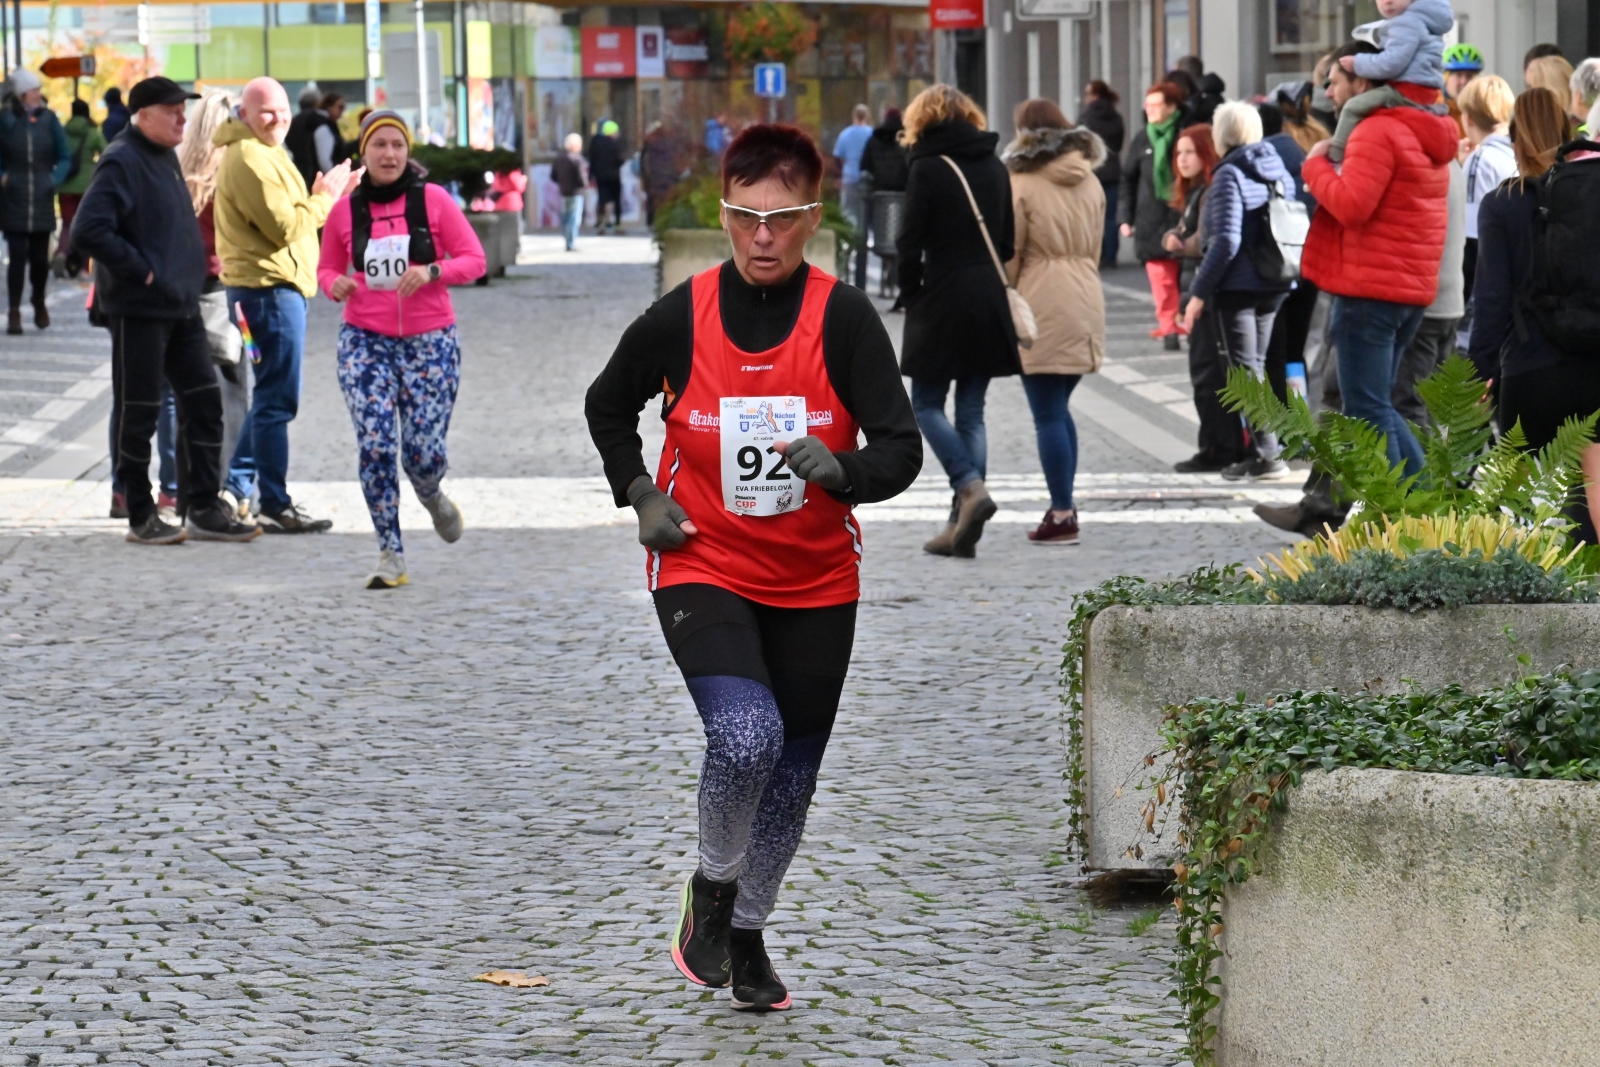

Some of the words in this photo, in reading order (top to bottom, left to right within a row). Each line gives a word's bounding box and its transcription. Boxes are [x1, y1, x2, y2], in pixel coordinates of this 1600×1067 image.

[366, 258, 407, 277] 610
[688, 410, 720, 427] Krako
[737, 445, 791, 481] 92
[750, 483, 793, 492] FRIEBELOVÁ
[735, 500, 757, 509] CUP
